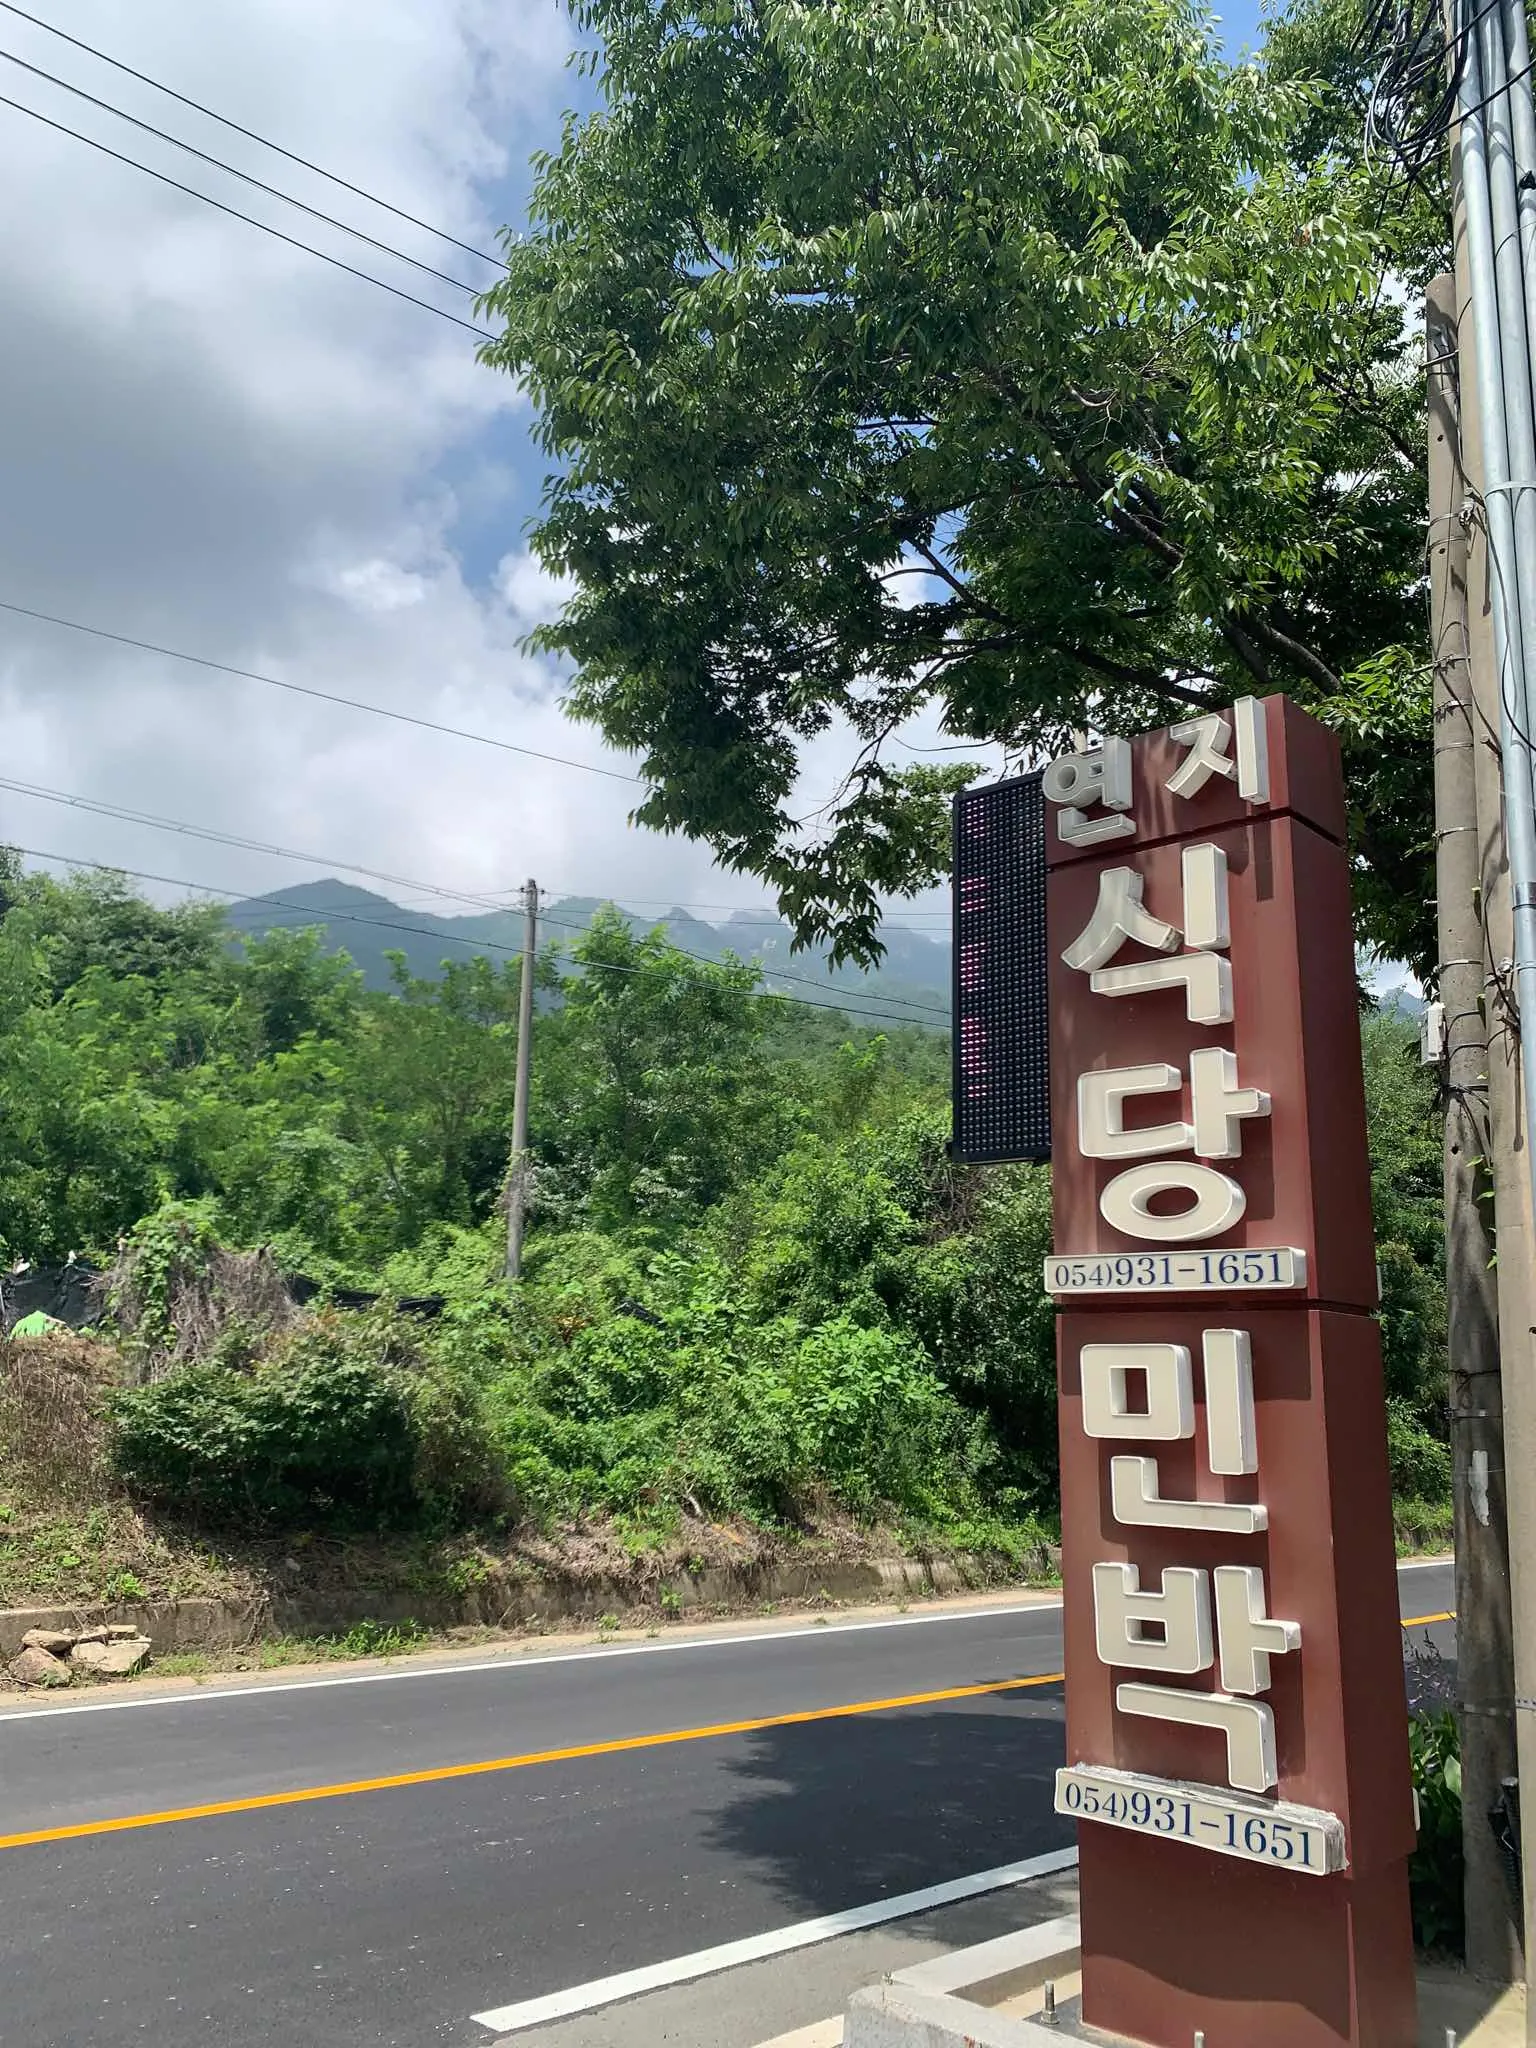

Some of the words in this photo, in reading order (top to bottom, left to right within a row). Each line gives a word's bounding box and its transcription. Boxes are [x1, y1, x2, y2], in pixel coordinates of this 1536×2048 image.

[1042, 694, 1270, 848] 연지
[1060, 842, 1272, 1242] 식당
[1055, 1253, 1286, 1287] 054)931-1651
[1080, 1328, 1302, 1793] 민박
[1065, 1782, 1315, 1868] 054)931-1651
